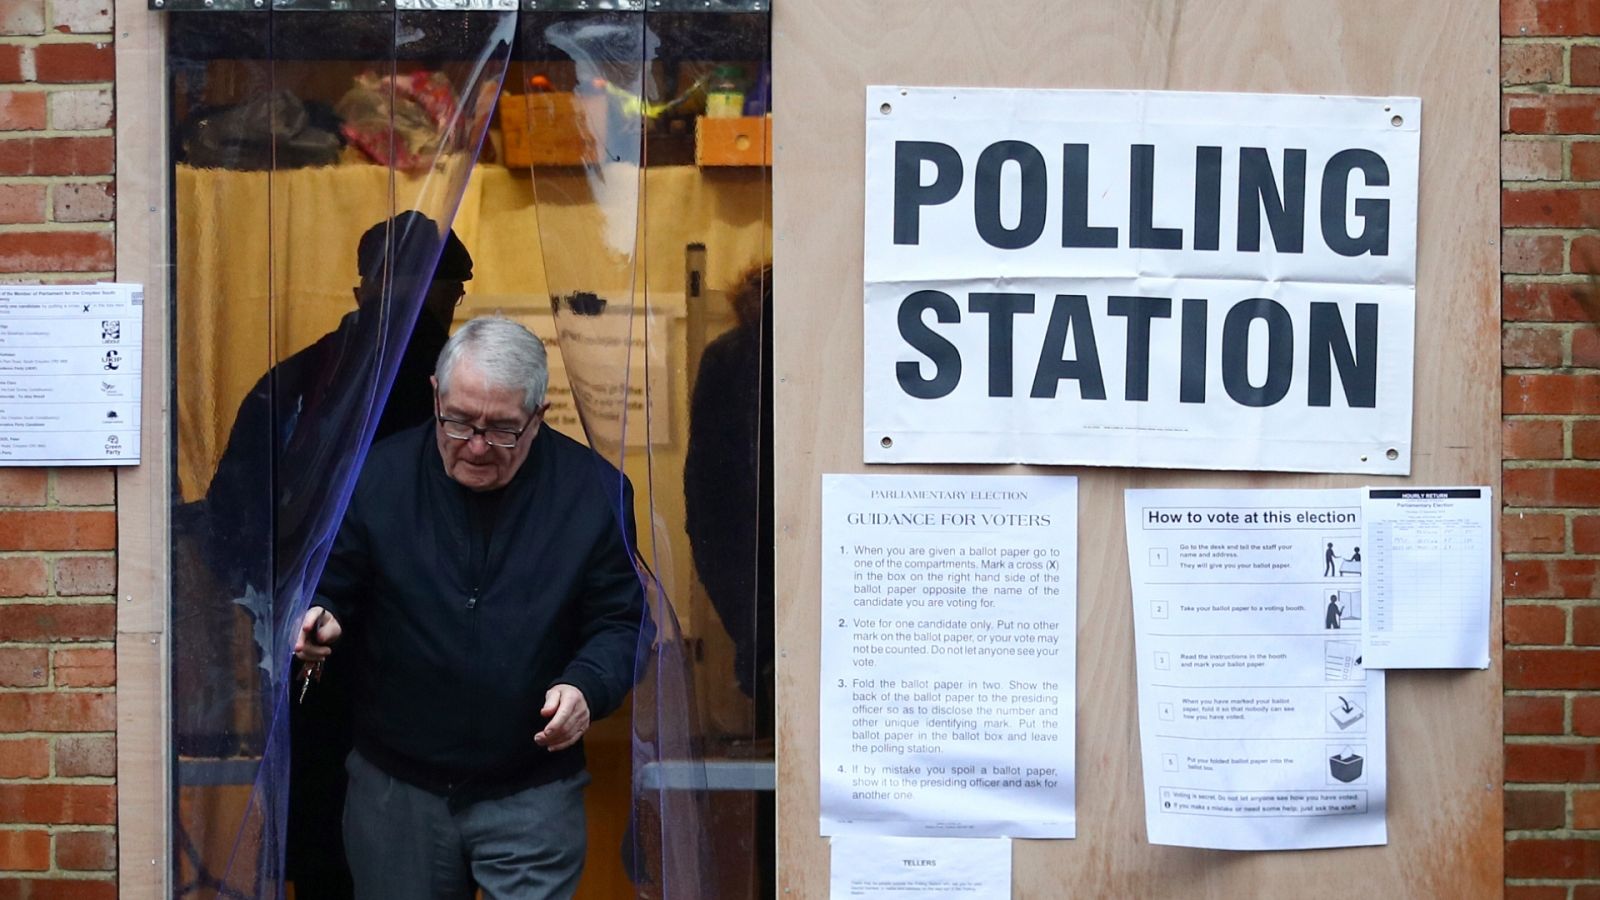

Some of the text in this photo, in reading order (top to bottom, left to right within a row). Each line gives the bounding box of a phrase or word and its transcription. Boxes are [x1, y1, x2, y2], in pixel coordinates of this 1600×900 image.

[893, 140, 1391, 257] POLLING
[895, 290, 1379, 408] STATION
[871, 491, 1028, 500] PARLIAMENTARY ELECTION
[848, 513, 1050, 526] GUIDANCE FOR VOTERS
[1149, 511, 1355, 523] How to vote at this election
[840, 546, 848, 554] 1.
[854, 546, 883, 555] When
[887, 548, 905, 557] you
[929, 548, 955, 557] given
[960, 548, 965, 556] a
[970, 547, 996, 556] ballot
[1001, 549, 1029, 558] paper
[1034, 549, 1046, 558] go
[1050, 548, 1060, 557] to
[854, 560, 872, 568] one
[875, 558, 884, 568] of
[887, 559, 902, 568] the
[982, 560, 1005, 568] Mark
[1016, 561, 1043, 569] cross
[1046, 560, 1058, 569] (X)
[854, 572, 1059, 583] in the box on the right hand side of the
[854, 584, 881, 593] ballot
[888, 586, 916, 596] paper
[922, 586, 966, 596] opposite
[972, 586, 988, 594] the
[1028, 586, 1038, 595] of
[1044, 587, 1059, 595] the
[854, 598, 903, 606] candidate
[906, 600, 924, 608] you
[947, 599, 977, 609] voting
[839, 619, 847, 627] 2.
[853, 618, 875, 628] Vote
[879, 619, 892, 628] for
[918, 620, 967, 629] candidate
[997, 620, 1014, 629] Put
[1017, 622, 1030, 630] no
[1033, 621, 1059, 630] other
[854, 632, 878, 640] mark
[881, 633, 893, 641] on
[896, 632, 911, 641] the
[914, 632, 941, 641] ballot
[990, 635, 1011, 644] your
[1038, 636, 1059, 644] may
[838, 679, 847, 687] 3.
[852, 679, 874, 688] Fold
[880, 680, 896, 688] the
[901, 680, 928, 688] ballot
[934, 682, 963, 690] paper
[968, 680, 978, 688] in
[1009, 680, 1037, 689] Show
[1042, 682, 1058, 690] the
[852, 704, 882, 714] officer
[887, 706, 899, 714] so
[918, 706, 928, 714] to
[932, 706, 972, 715] disclose
[977, 706, 992, 715] the
[852, 718, 878, 727] other
[885, 720, 919, 728] unique
[926, 718, 977, 729] identifying
[1019, 719, 1035, 728] Put
[1042, 720, 1058, 728] the
[852, 744, 868, 752] the
[871, 744, 904, 754] polling
[852, 765, 858, 773] If
[864, 765, 876, 776] by
[882, 766, 920, 774] mistake
[927, 766, 945, 776] you
[952, 765, 975, 775] spoil
[993, 766, 1020, 775] ballot
[852, 791, 890, 799] another
